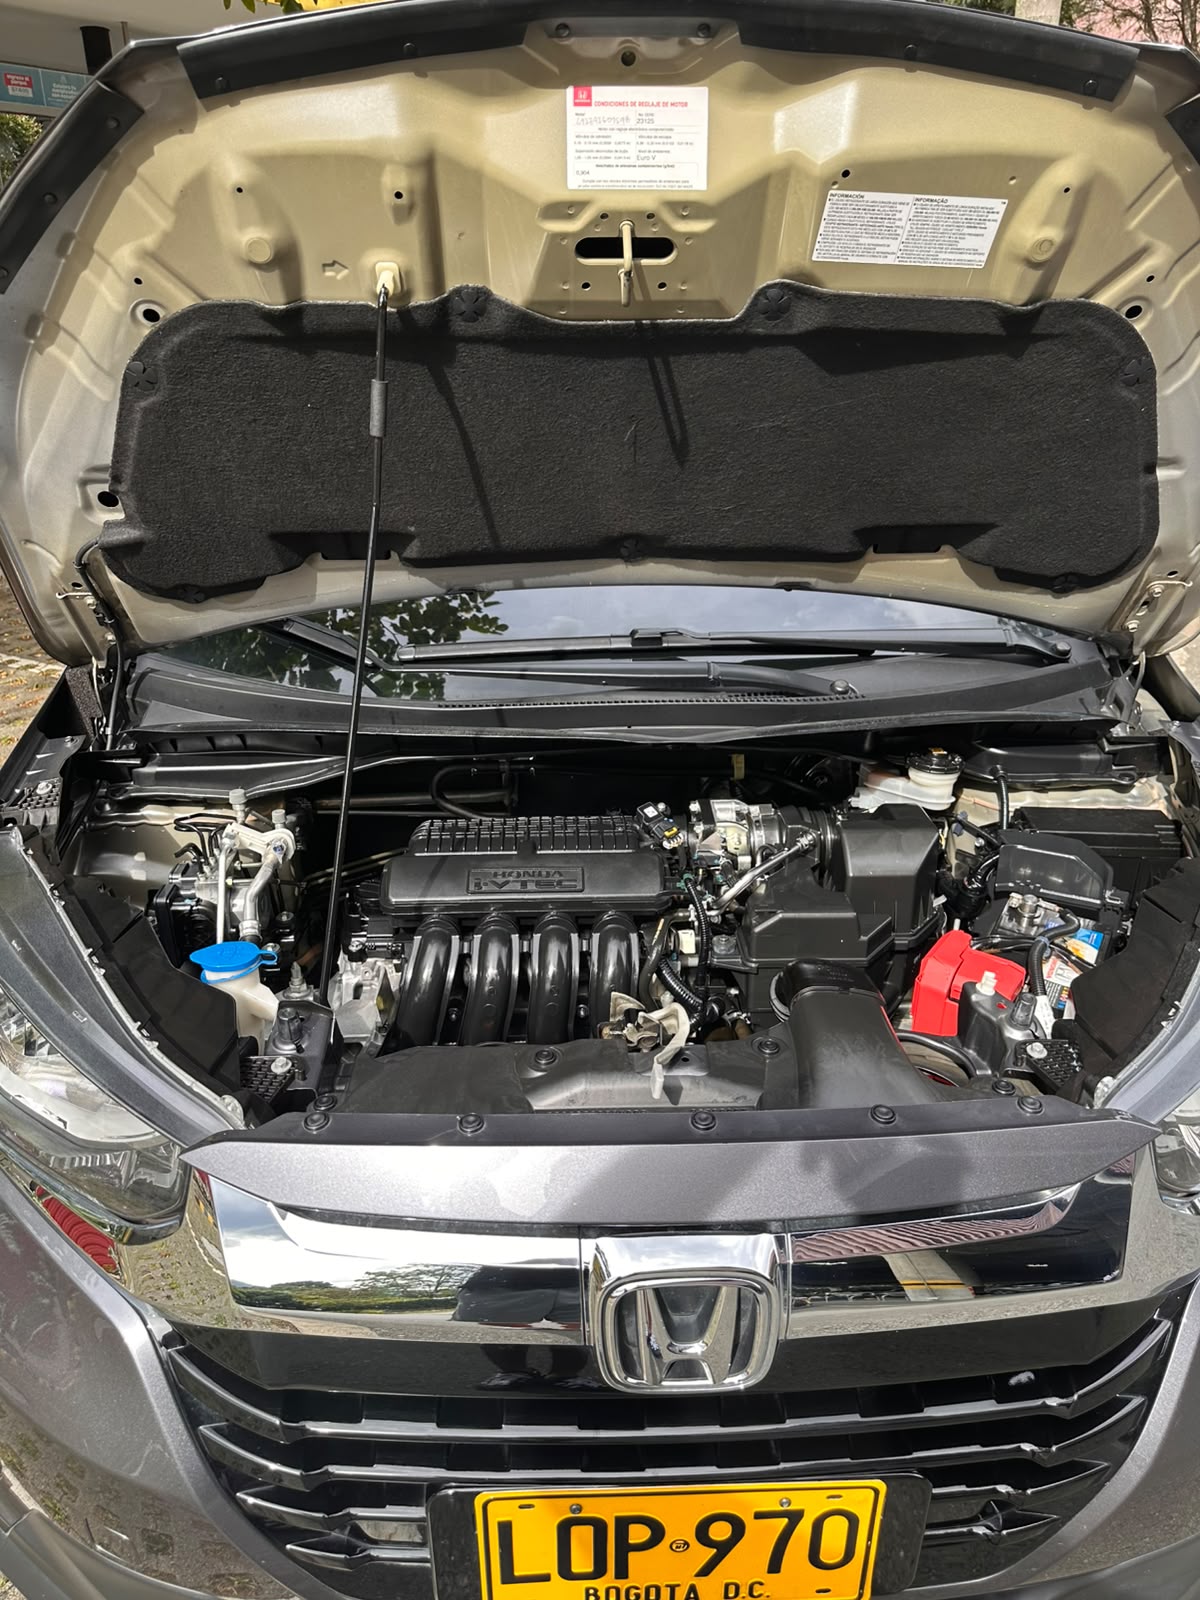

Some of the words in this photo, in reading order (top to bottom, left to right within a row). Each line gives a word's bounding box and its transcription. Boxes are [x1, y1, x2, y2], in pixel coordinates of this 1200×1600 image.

[493, 870, 564, 879] HONDA
[497, 1514, 666, 1584] LOP
[693, 1507, 860, 1577] 970
[584, 1583, 700, 1600] BOGOTA
[723, 1580, 771, 1600] D.C.
